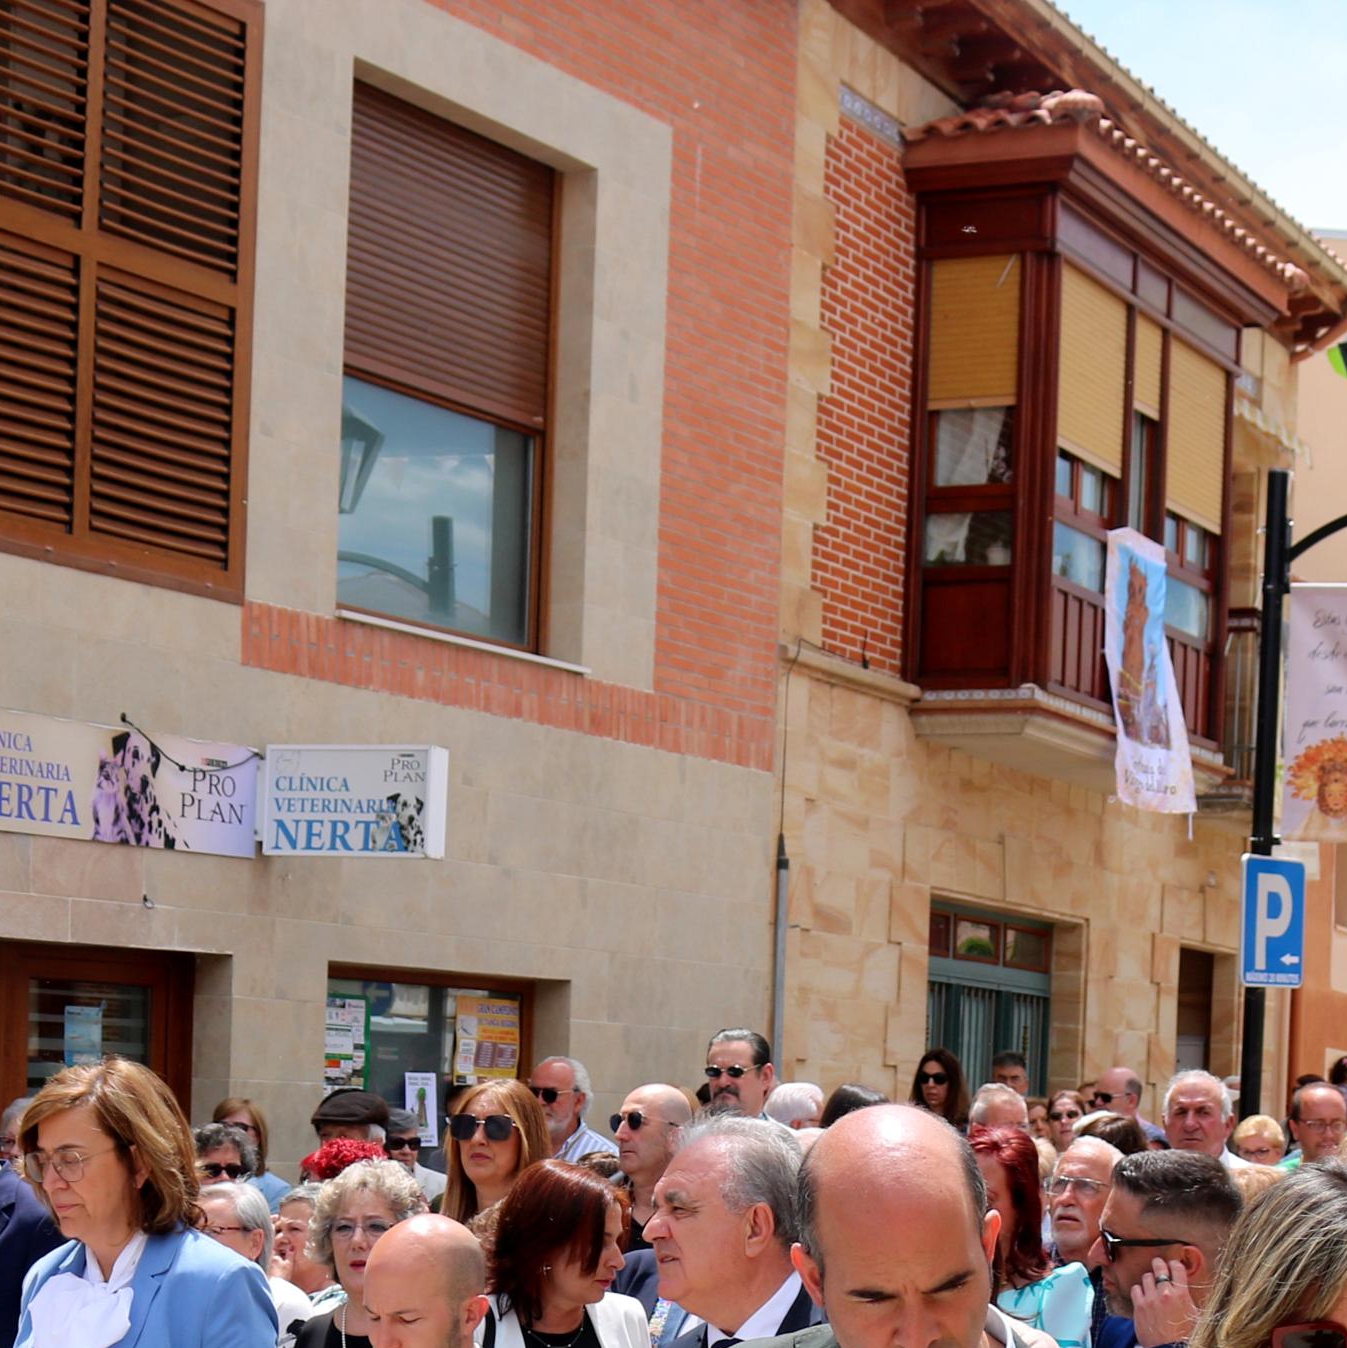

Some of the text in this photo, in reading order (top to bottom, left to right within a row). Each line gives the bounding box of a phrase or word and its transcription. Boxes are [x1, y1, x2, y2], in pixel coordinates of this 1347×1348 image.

[383, 770, 426, 782] PLAN
[391, 758, 420, 770] PRO
[192, 767, 236, 797] PRO
[275, 773, 350, 792] CLÍNICA
[180, 793, 247, 825] PLAN
[273, 798, 397, 814] VETERINARIA
[272, 819, 409, 852] NERTA
[1255, 872, 1293, 970] P
